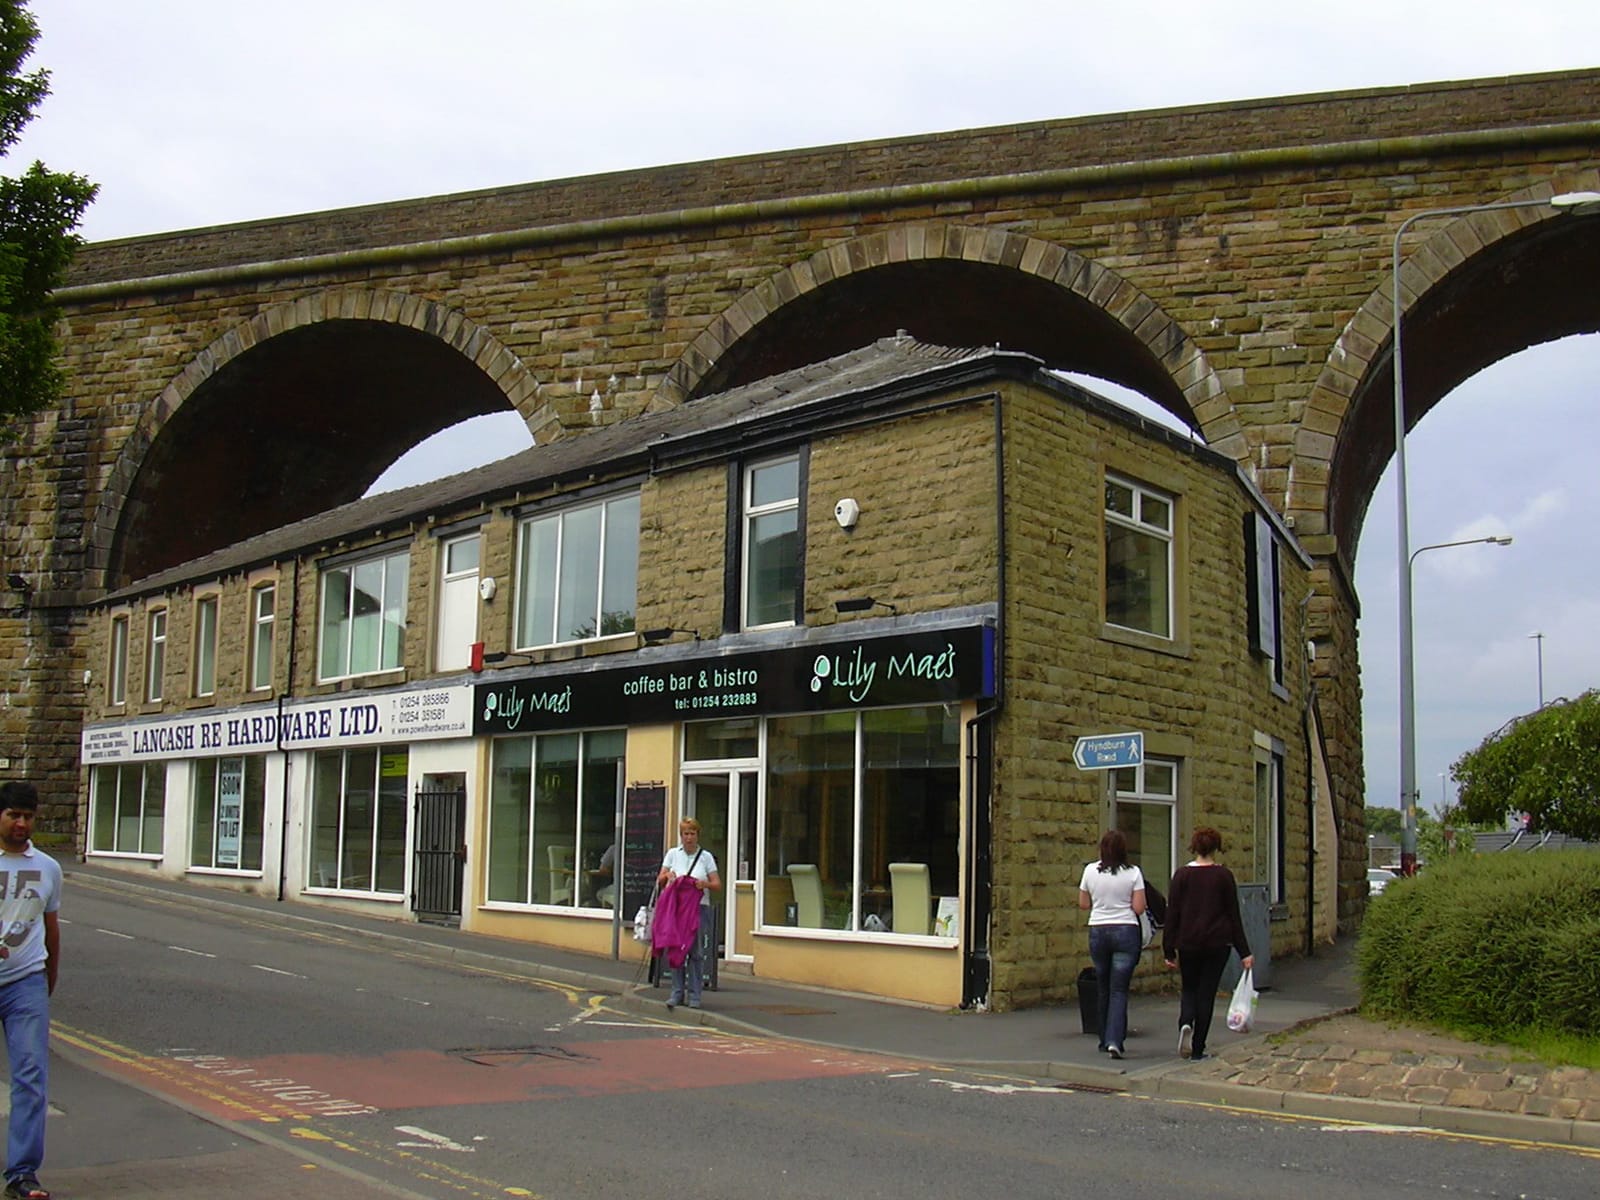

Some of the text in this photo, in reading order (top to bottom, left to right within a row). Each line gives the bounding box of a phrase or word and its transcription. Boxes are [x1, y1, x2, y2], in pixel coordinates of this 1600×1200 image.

[623, 668, 758, 695] coffee bar & bistro
[833, 643, 956, 702] Lily Mae's
[399, 696, 420, 708] 01254
[497, 685, 572, 730] Lily Mae's
[675, 692, 758, 710] tel: 01254 232883
[399, 711, 419, 723] 01254
[133, 704, 383, 754] LANCASH RE HARDWARE LTD.
[1087, 741, 1126, 752] Hyndburn
[1096, 752, 1117, 762] Road
